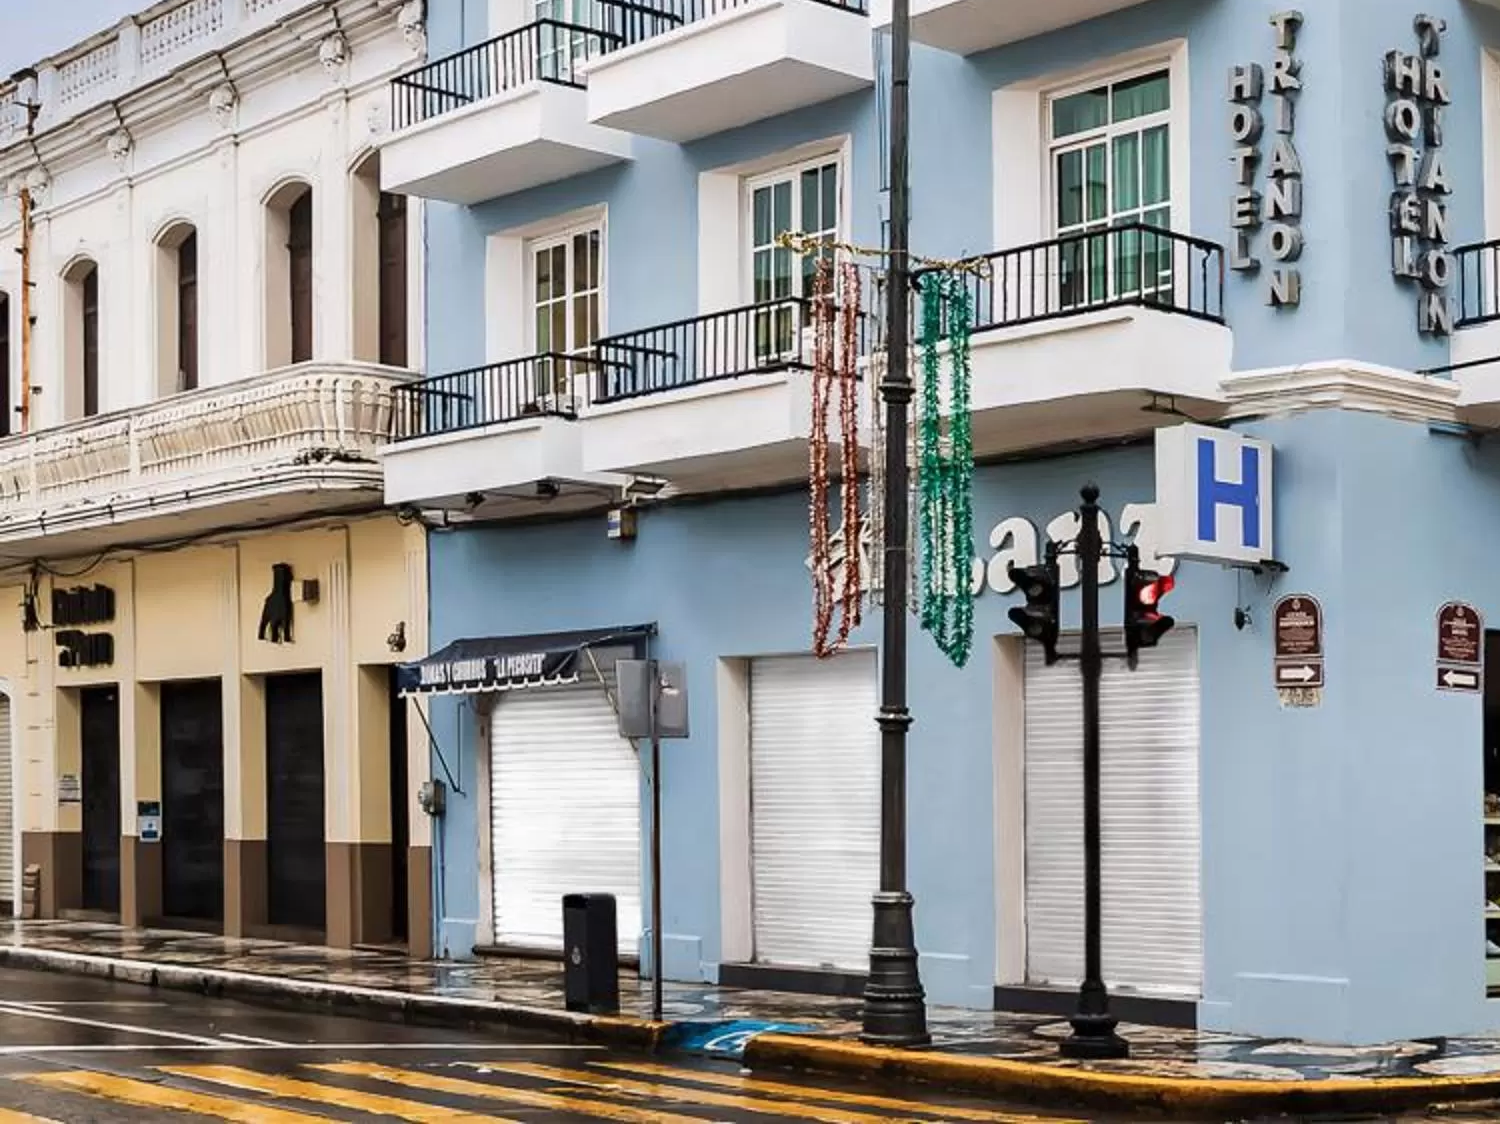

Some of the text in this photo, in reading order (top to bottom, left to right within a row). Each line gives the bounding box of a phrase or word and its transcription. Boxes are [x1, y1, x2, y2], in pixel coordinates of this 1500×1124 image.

[1227, 63, 1263, 272] HOTEL
[1265, 10, 1303, 306] TRIANON
[1385, 49, 1423, 280] HOTEL
[1414, 13, 1453, 336] TRIANON
[1197, 437, 1260, 549] H
